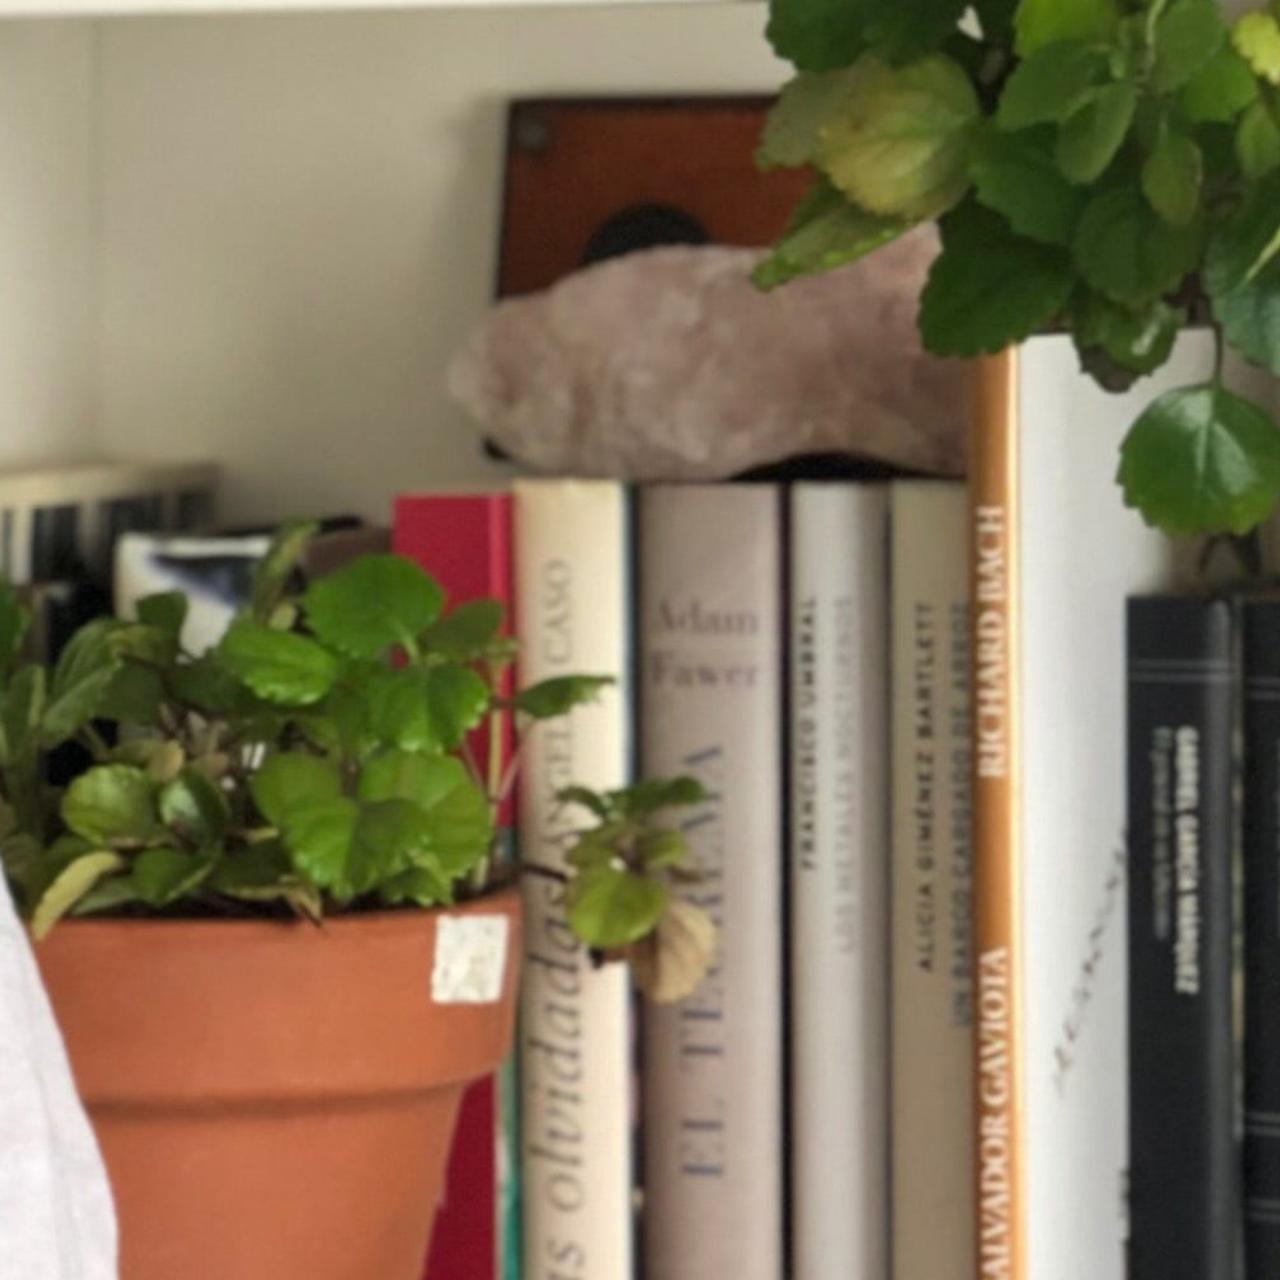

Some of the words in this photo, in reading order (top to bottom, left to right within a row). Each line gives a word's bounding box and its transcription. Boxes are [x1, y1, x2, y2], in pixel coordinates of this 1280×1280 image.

[976, 505, 1007, 602] BACH
[543, 559, 576, 667] CASO
[655, 599, 758, 636] Adam
[799, 595, 817, 708] UMBRAL
[650, 654, 760, 689] Fawer
[915, 601, 935, 740] BARTLETT
[977, 611, 1009, 779] RICHARD
[799, 720, 818, 872] FRANCISCO
[911, 750, 934, 872] GIMÉNEZ
[1175, 725, 1199, 812] GABRIEL
[834, 771, 857, 896] METALES
[1175, 814, 1201, 892] GARCÍA
[834, 903, 858, 954] LOS
[914, 883, 935, 973] ALICIA
[1173, 894, 1202, 995] MÁRQUEZ
[526, 872, 587, 1214] olvidadas
[979, 946, 1013, 1108] GAVIOTA
[681, 1100, 726, 1180] EL
